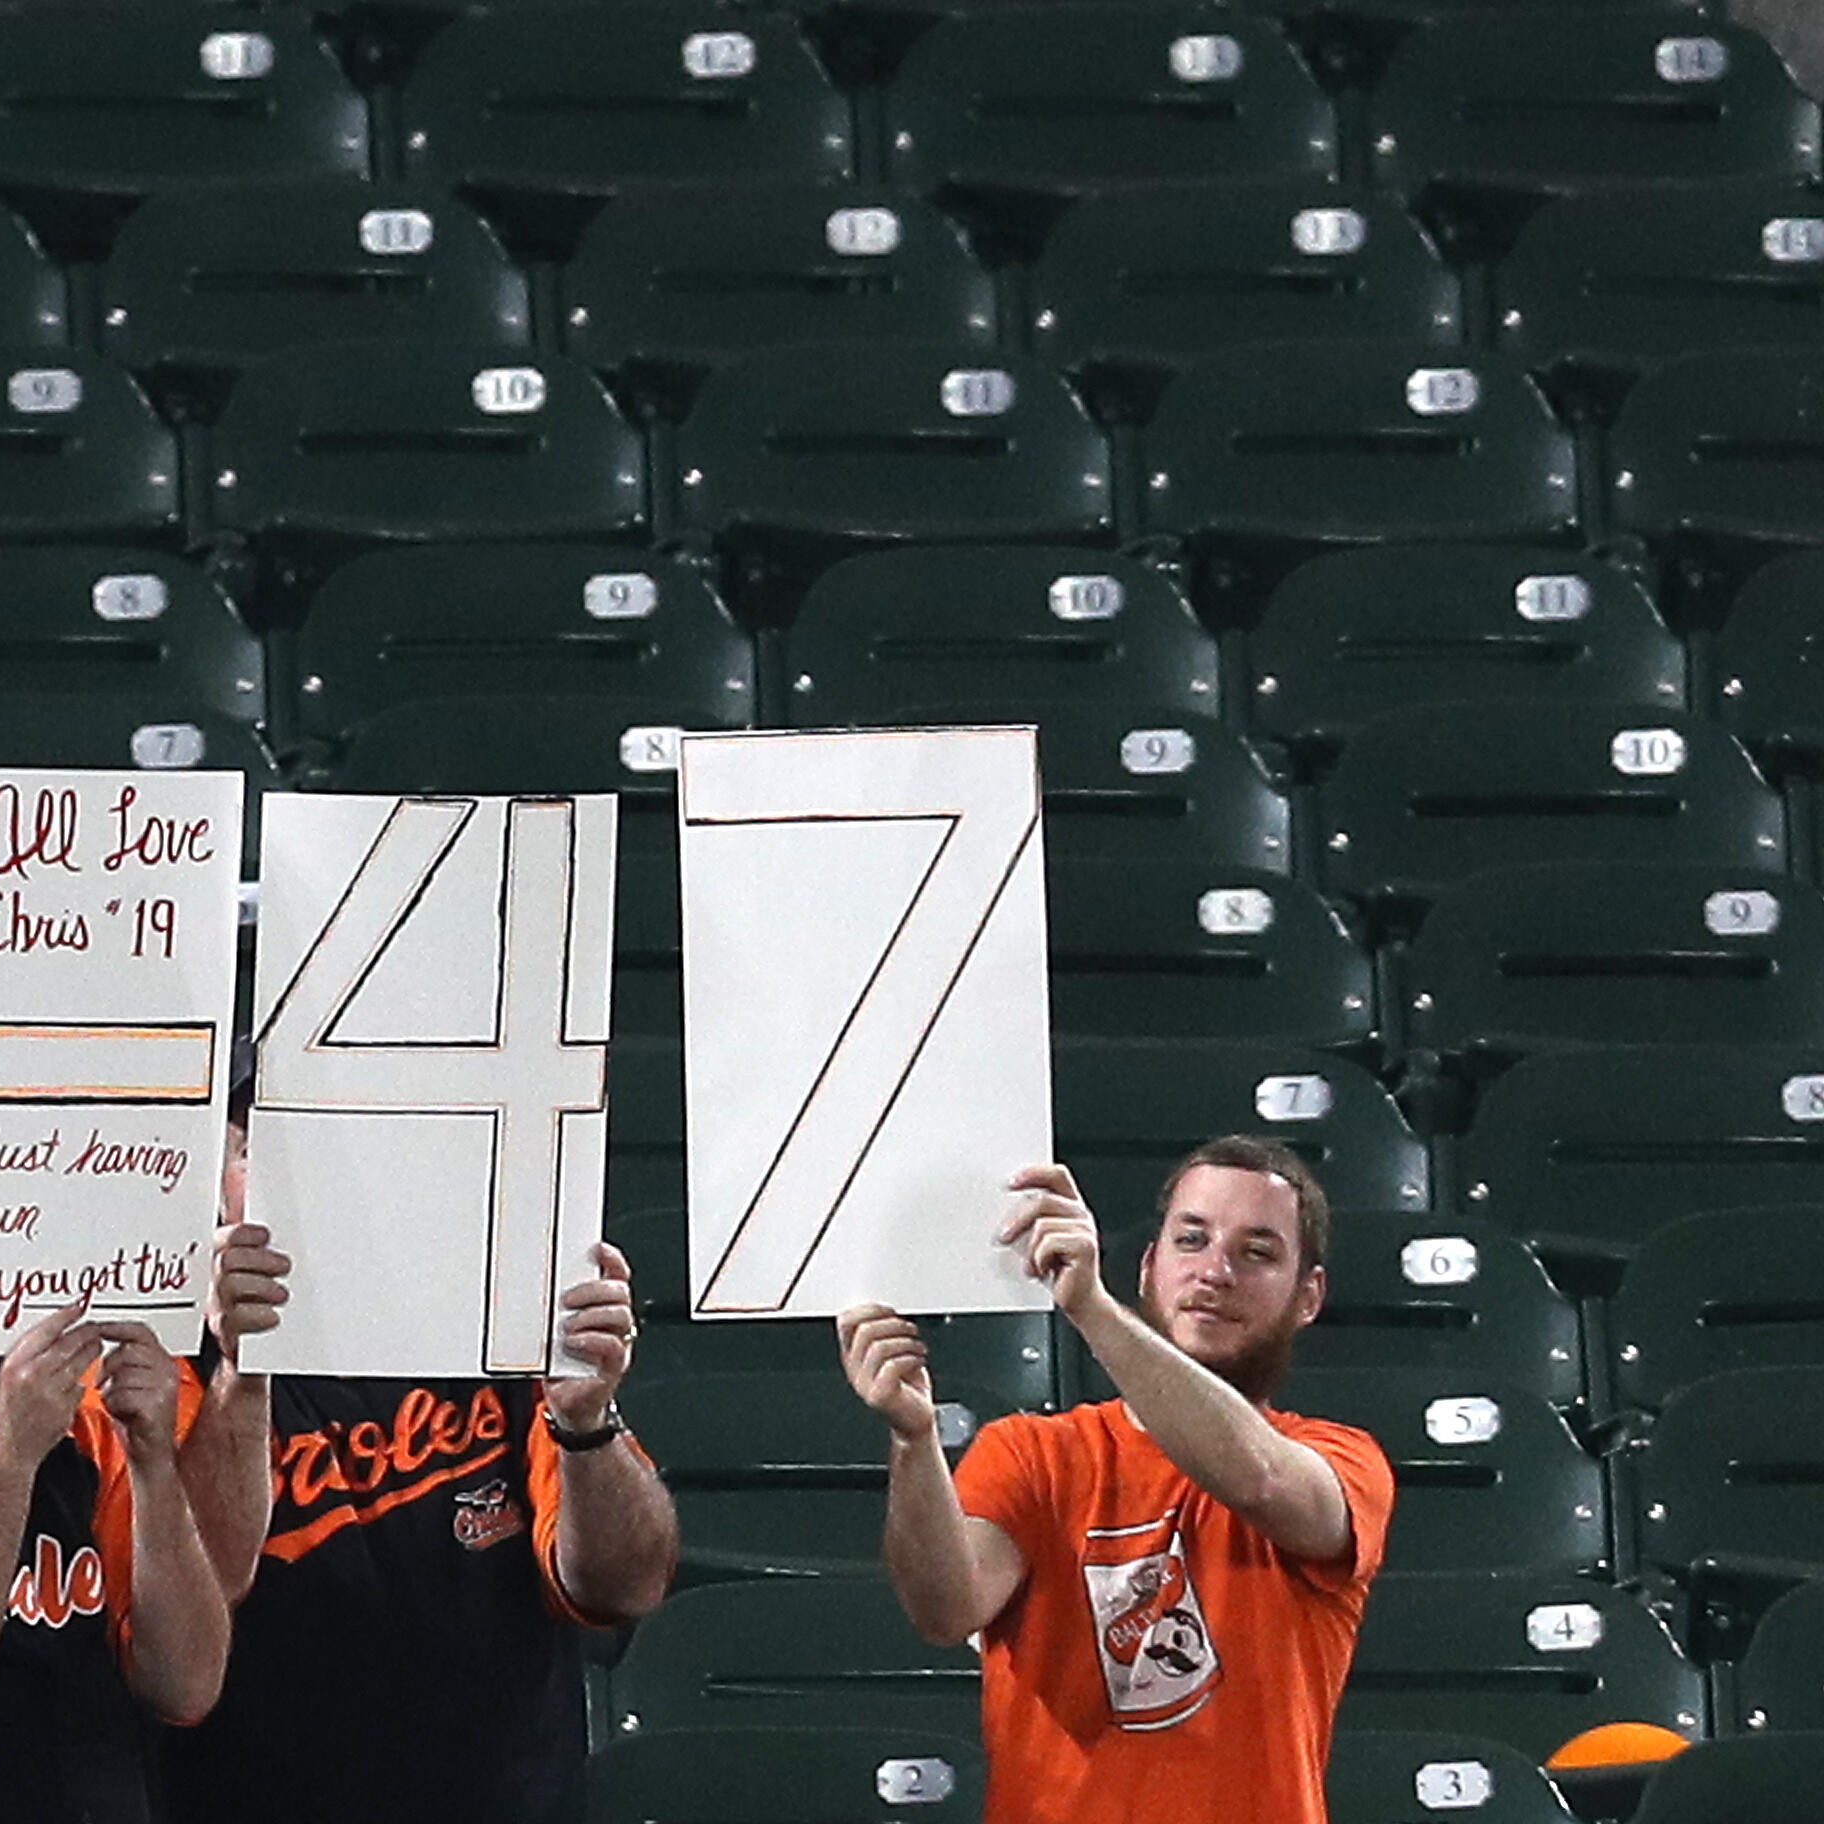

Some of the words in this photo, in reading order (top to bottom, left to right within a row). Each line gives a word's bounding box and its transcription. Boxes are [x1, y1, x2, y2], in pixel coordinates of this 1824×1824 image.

[381, 219, 412, 247] 11
[34, 377, 52, 406] 9
[494, 375, 529, 404] 10
[963, 377, 989, 406] 11
[1428, 376, 1461, 406] 12
[121, 583, 140, 613] 8
[609, 580, 628, 609] 9
[1071, 583, 1106, 612] 10
[1538, 583, 1566, 613] 11
[158, 731, 175, 761] 7
[645, 734, 664, 763] 8
[1145, 737, 1167, 766] 9
[1634, 737, 1669, 767] 10
[103, 786, 214, 872] Love
[1224, 896, 1244, 925] 8
[1730, 897, 1750, 925] 9
[680, 725, 1038, 1312] 7
[254, 797, 610, 1373] 4
[1282, 1082, 1302, 1113] 7
[63, 1129, 188, 1194] having
[1429, 1245, 1451, 1276] 6
[78, 1249, 125, 1312] got
[1454, 1405, 1473, 1436] 5
[266, 1387, 508, 1506] rioles
[1554, 1611, 1575, 1641] 4
[904, 1765, 923, 1795] 2
[1443, 1770, 1462, 1800] 3
